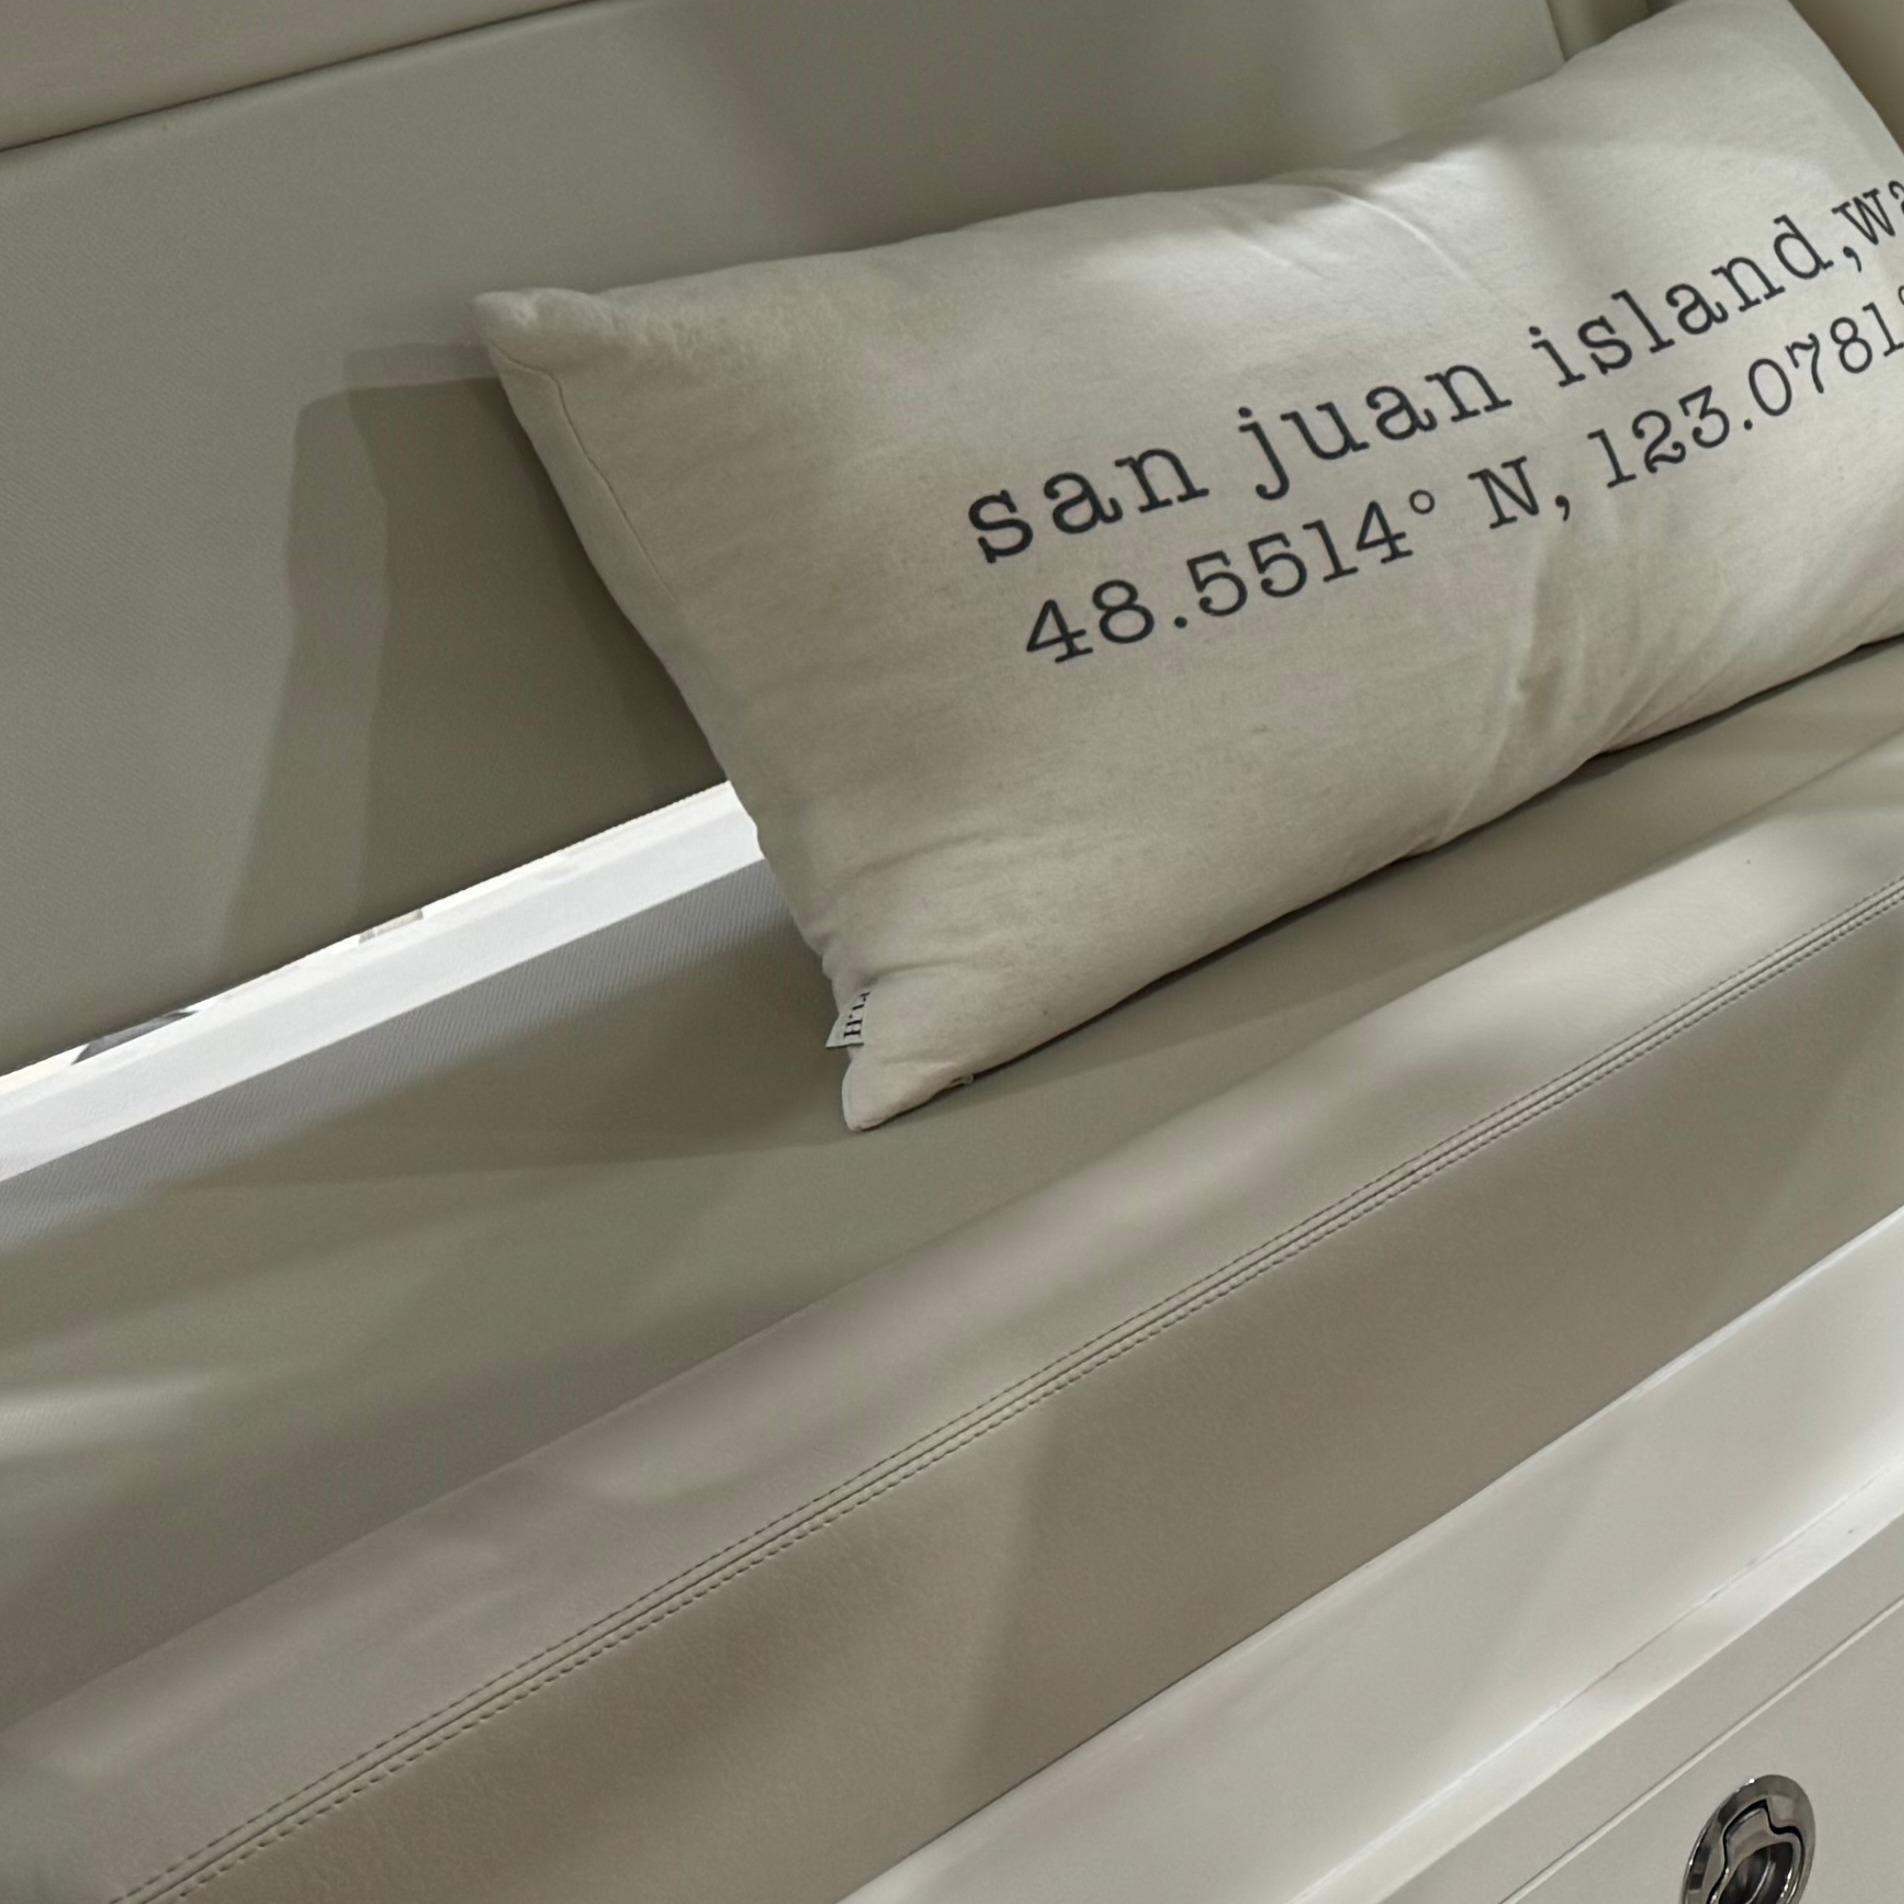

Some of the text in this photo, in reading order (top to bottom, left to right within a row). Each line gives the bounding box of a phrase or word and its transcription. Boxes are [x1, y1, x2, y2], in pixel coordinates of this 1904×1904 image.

[967, 447, 1211, 565] san
[1237, 364, 1513, 502] juan
[1025, 488, 1436, 665] 48.5514°
[1467, 454, 1571, 530] N,
